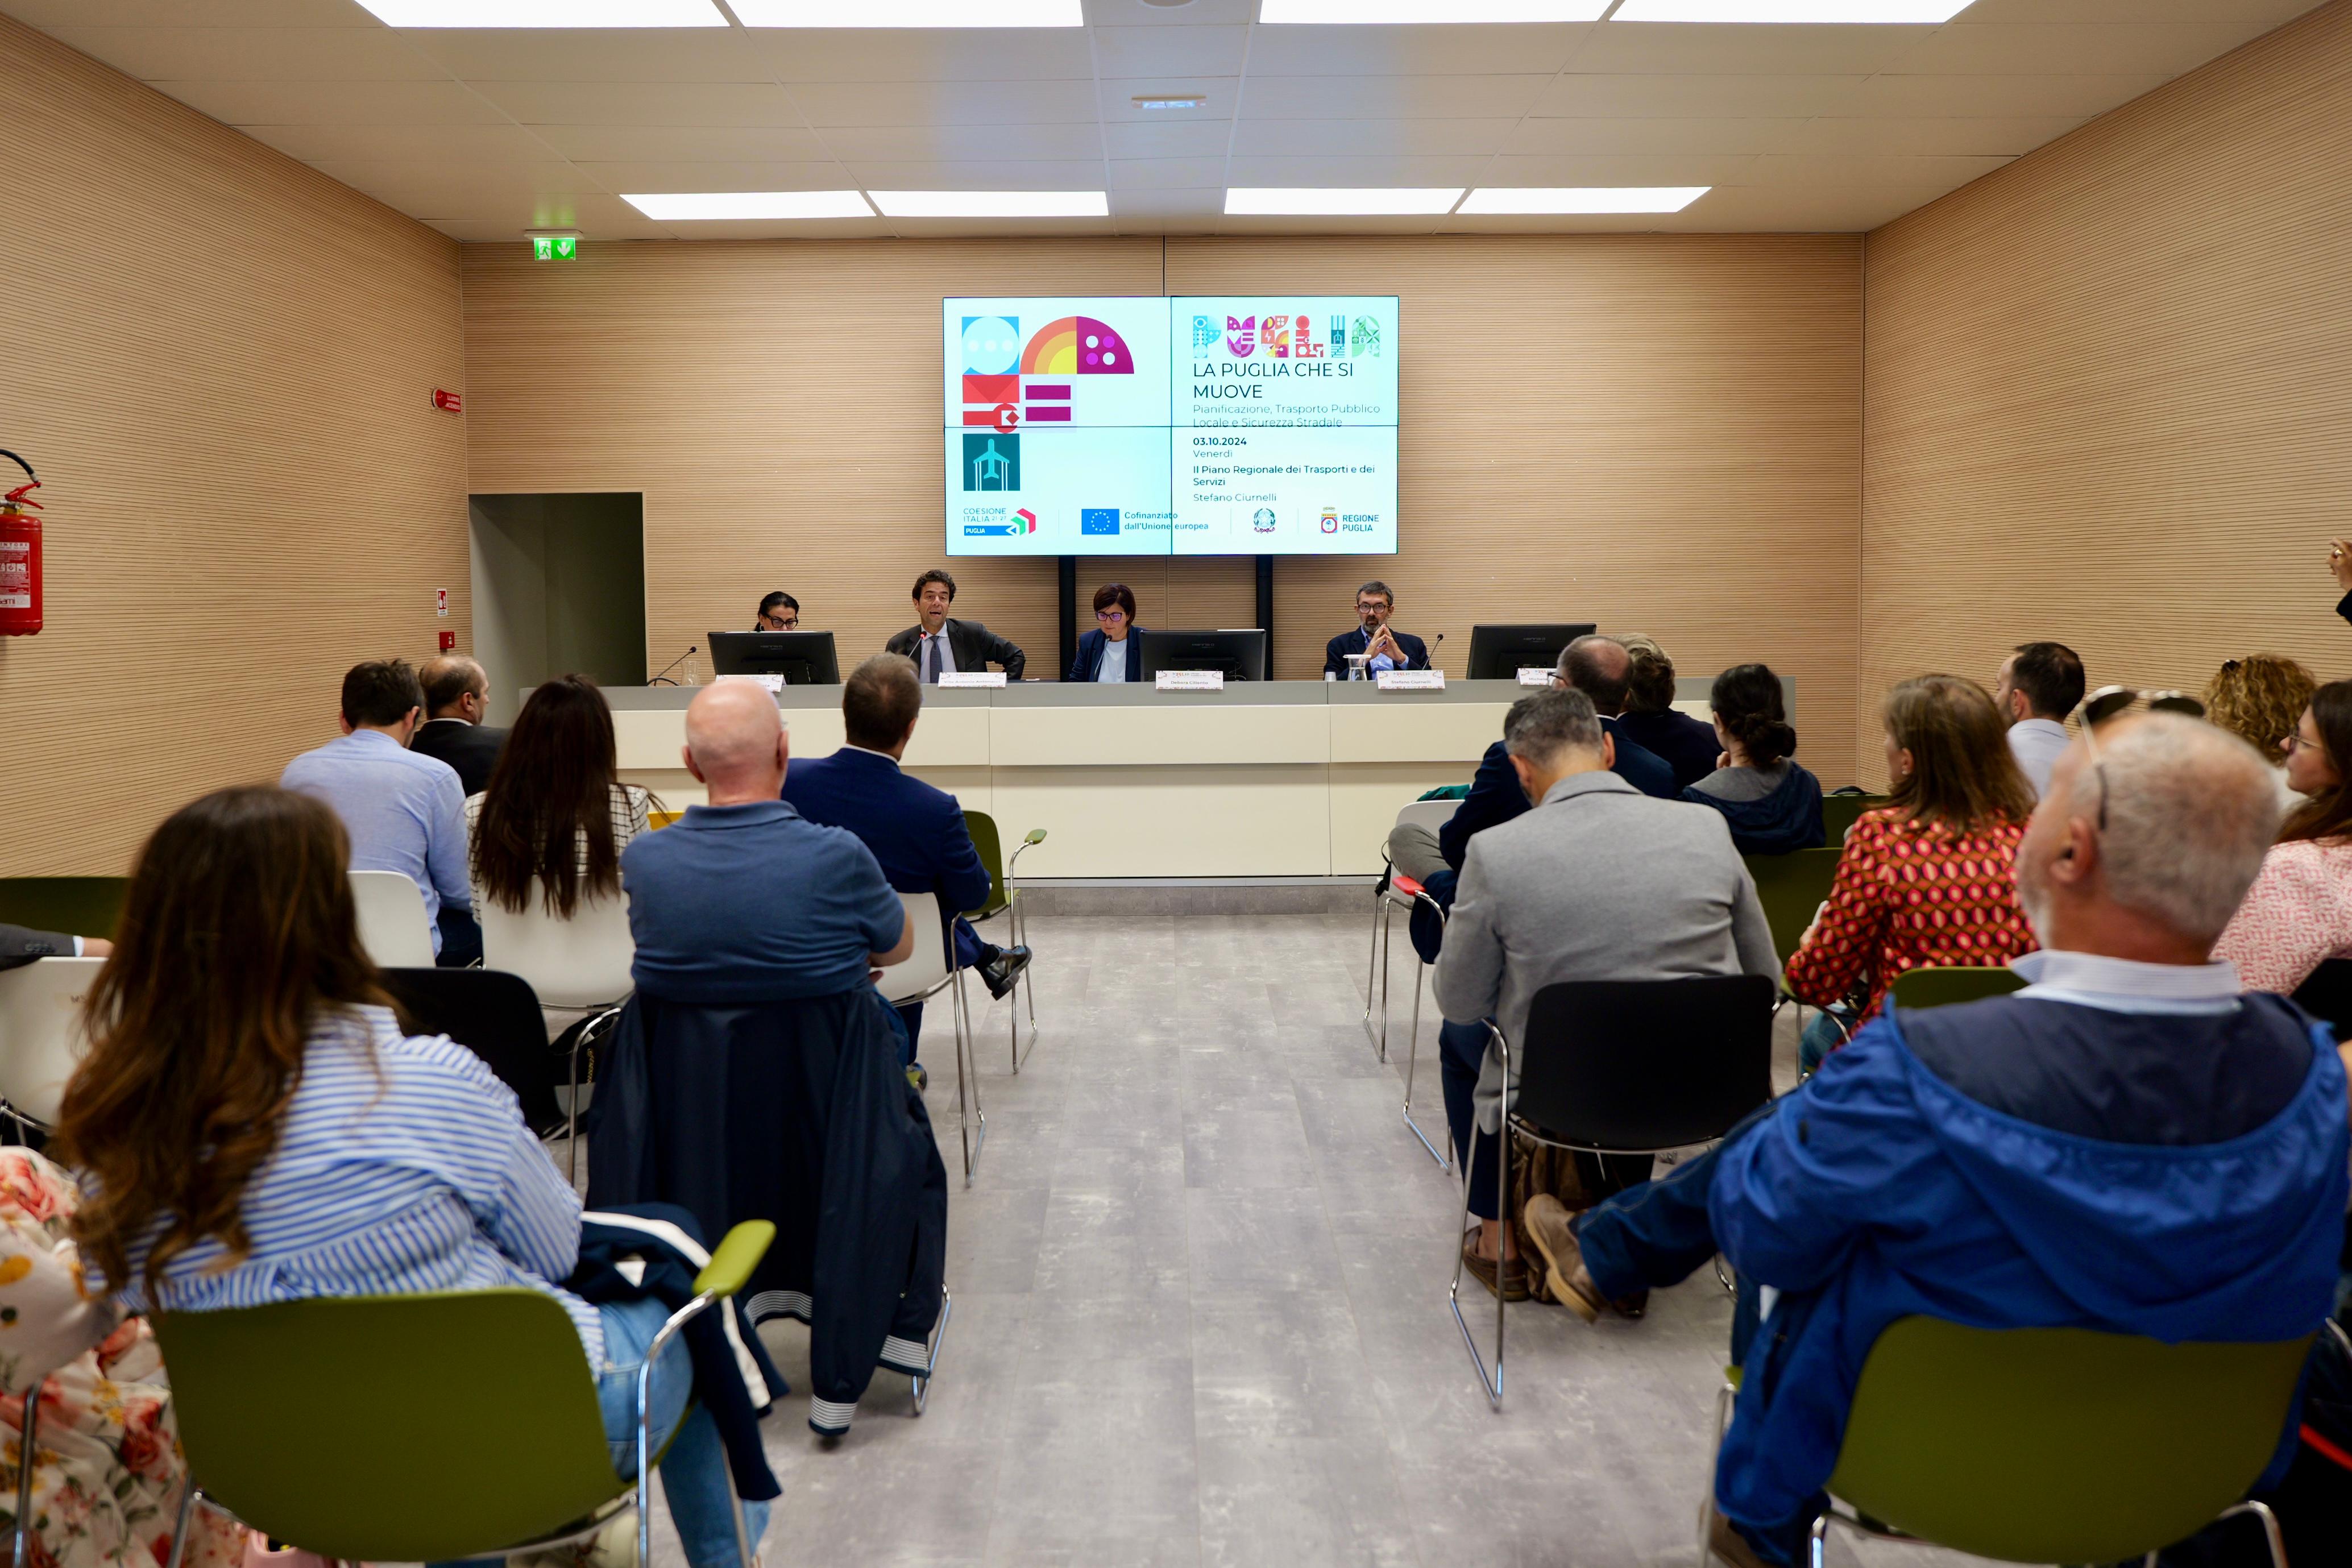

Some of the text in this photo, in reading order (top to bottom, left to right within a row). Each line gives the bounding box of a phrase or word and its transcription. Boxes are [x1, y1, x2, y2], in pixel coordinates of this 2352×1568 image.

[1193, 362, 1353, 377] LA PUGLIA CHE SI
[1193, 384, 1263, 399] MUOVE
[1193, 404, 1380, 415] Pianificazione, Trasporto Pubblico
[1193, 418, 1229, 428] Locale
[1241, 417, 1293, 428] Sicurezza
[1297, 417, 1342, 428] Stradale
[1193, 437, 1247, 446] 03.10.2024
[1193, 465, 1199, 474] Il
[1201, 465, 1231, 474] Piano
[1233, 465, 1283, 475] Regionale
[1285, 465, 1301, 474] dei
[1304, 465, 1349, 475] Trasporti
[1359, 465, 1375, 474] dei
[1193, 478, 1226, 486] Servizi
[1193, 493, 1277, 502] Stefano Ciurnelli
